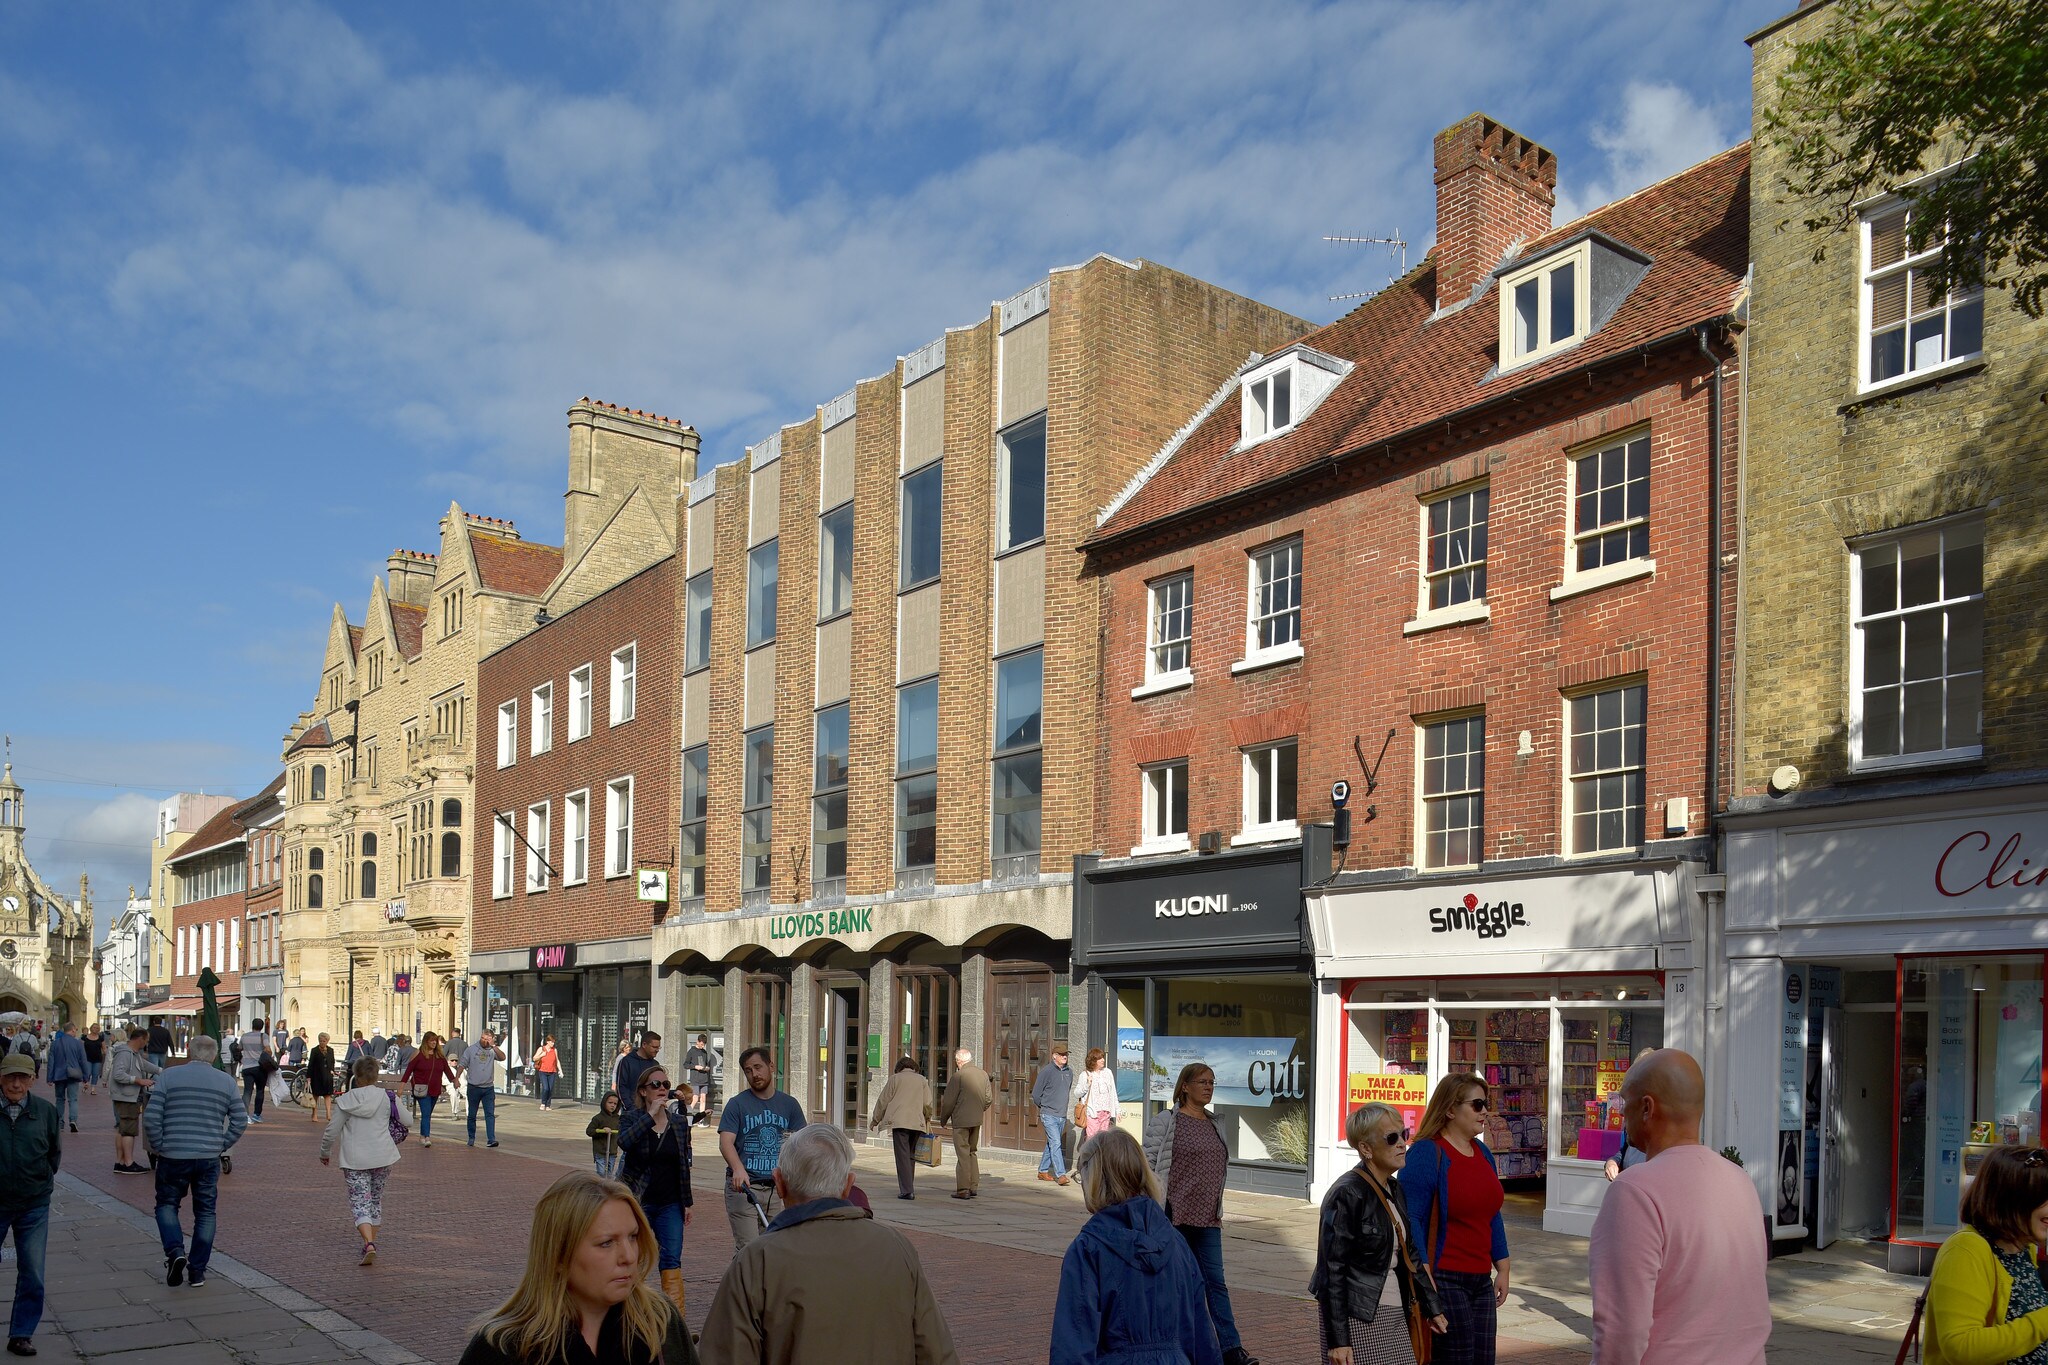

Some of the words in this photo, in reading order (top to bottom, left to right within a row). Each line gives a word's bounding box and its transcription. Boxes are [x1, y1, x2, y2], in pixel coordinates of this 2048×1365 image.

[1155, 894, 1228, 918] KUONI
[1240, 902, 1258, 912] 1906
[771, 913, 824, 939] LLOYDS
[829, 908, 872, 934] BANK
[544, 946, 566, 968] HMV
[1676, 984, 1684, 992] 13
[1810, 978, 1834, 991] BODY
[1785, 1026, 1802, 1034] BODY
[1600, 1062, 1628, 1070] SALE
[1248, 1054, 1305, 1099] cut
[1368, 1078, 1395, 1089] TAKE
[1397, 1079, 1405, 1089] A
[1350, 1089, 1400, 1101] FURTHER
[1403, 1090, 1424, 1102] OFF
[743, 1112, 762, 1134] JIM
